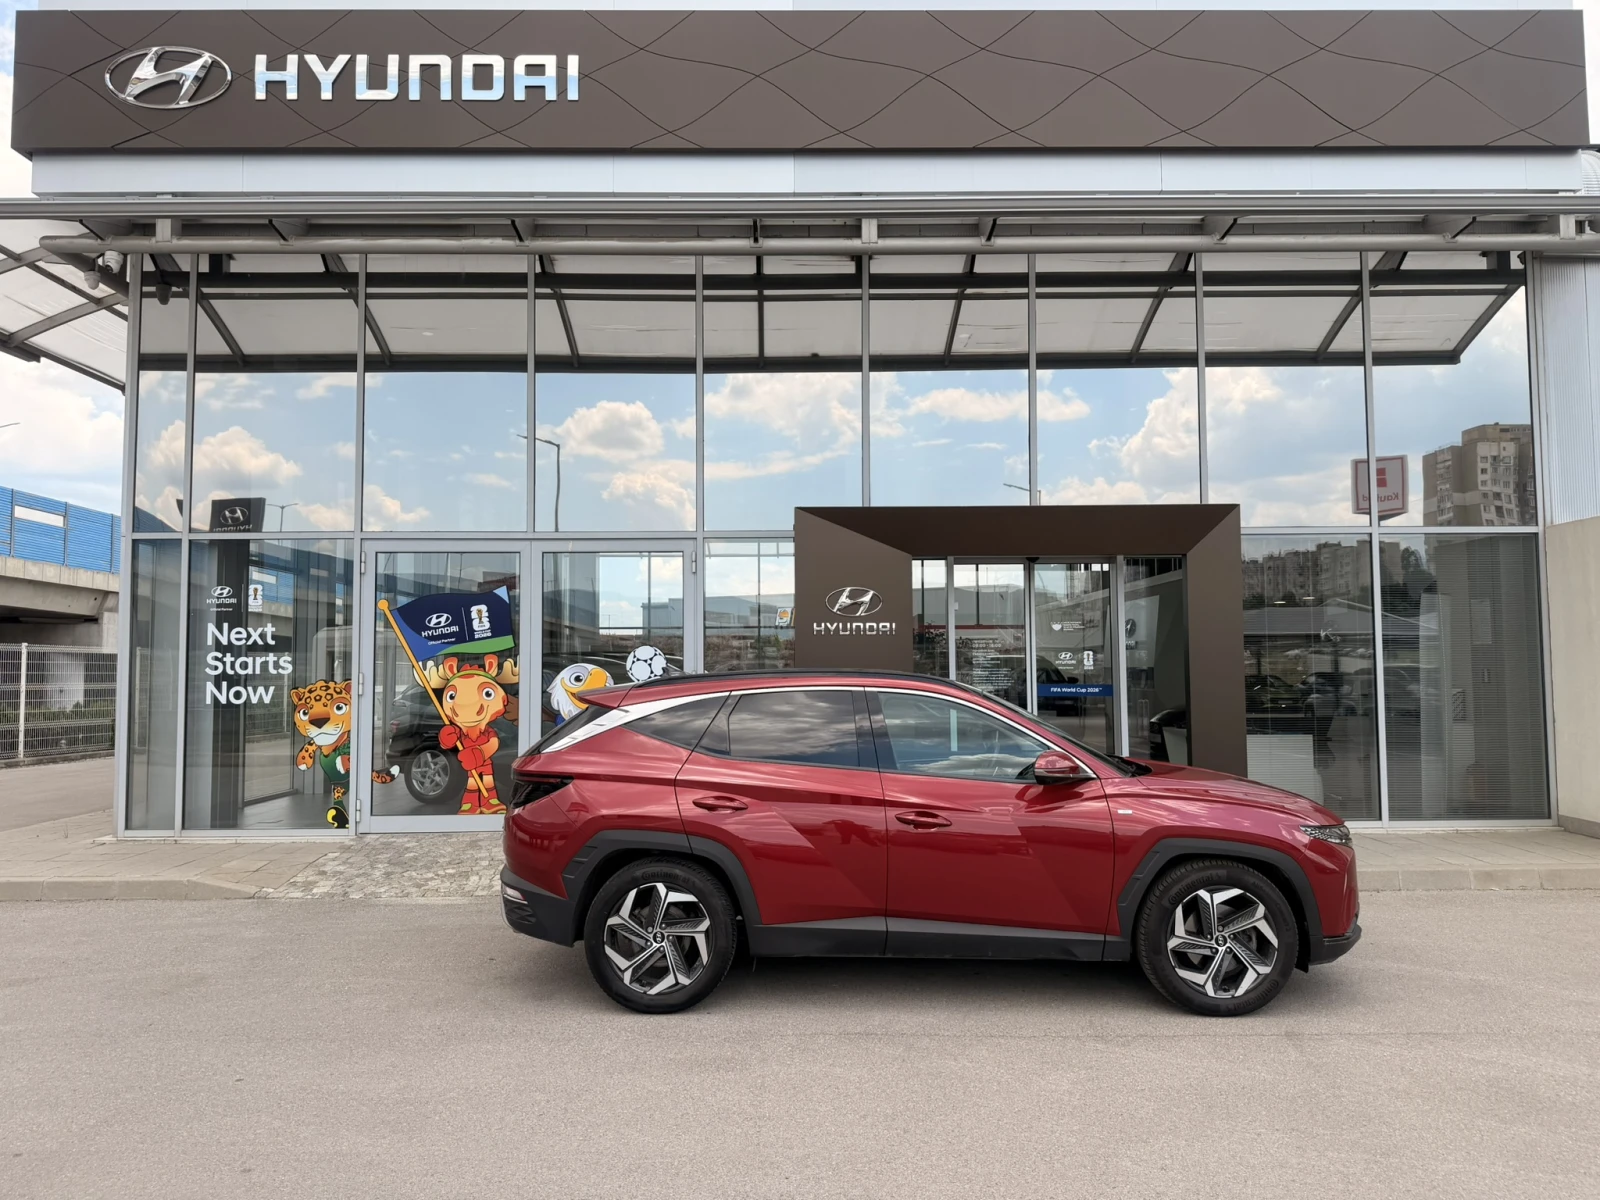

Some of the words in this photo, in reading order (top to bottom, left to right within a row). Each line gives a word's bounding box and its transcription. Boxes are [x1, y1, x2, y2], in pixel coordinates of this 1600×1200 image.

[254, 54, 579, 101] HYUNDAI
[207, 622, 276, 646] Next
[421, 625, 459, 637] HYUNDAI
[813, 622, 896, 635] HYUNDAI
[205, 651, 293, 675] Starts
[205, 681, 275, 704] Now
[1168, 872, 1214, 905] Continental
